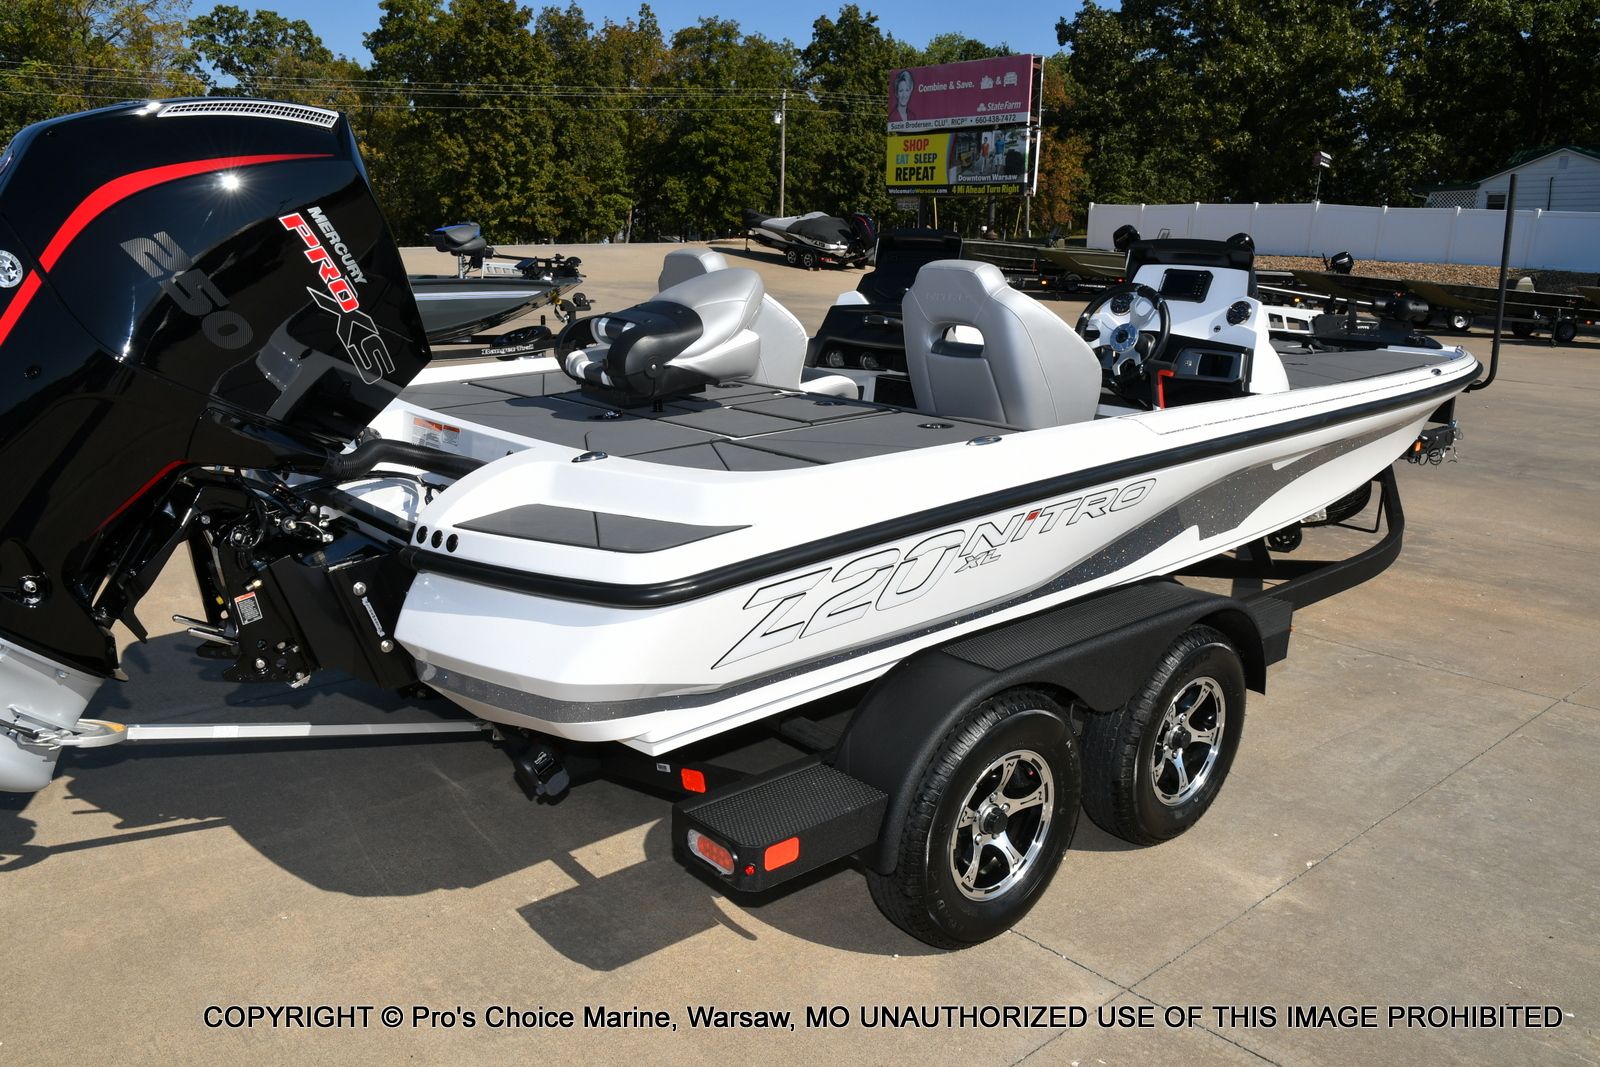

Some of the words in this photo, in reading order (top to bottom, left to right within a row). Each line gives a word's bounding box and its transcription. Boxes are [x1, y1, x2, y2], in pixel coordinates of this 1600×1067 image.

[918, 82, 947, 93] Combine
[949, 80, 955, 90] &
[956, 80, 975, 90] Save.
[890, 122, 904, 130] Suzie
[975, 114, 1017, 124] 660-438-7472
[903, 138, 930, 152] SHOP
[896, 153, 909, 165] EAT
[914, 152, 938, 164] SLEEP
[895, 166, 936, 182] REPEAT
[958, 174, 991, 182] Downtown
[992, 173, 1018, 181] Warsaw
[952, 185, 957, 194] 4
[957, 185, 966, 194] Mi
[966, 184, 986, 194] Ahead
[986, 184, 1001, 193] Turn
[1002, 184, 1020, 194] Right
[307, 206, 368, 285] MERCURY
[278, 212, 360, 314] PRO
[120, 231, 253, 350] 250
[954, 550, 1002, 575] XL
[711, 529, 967, 670] Z20
